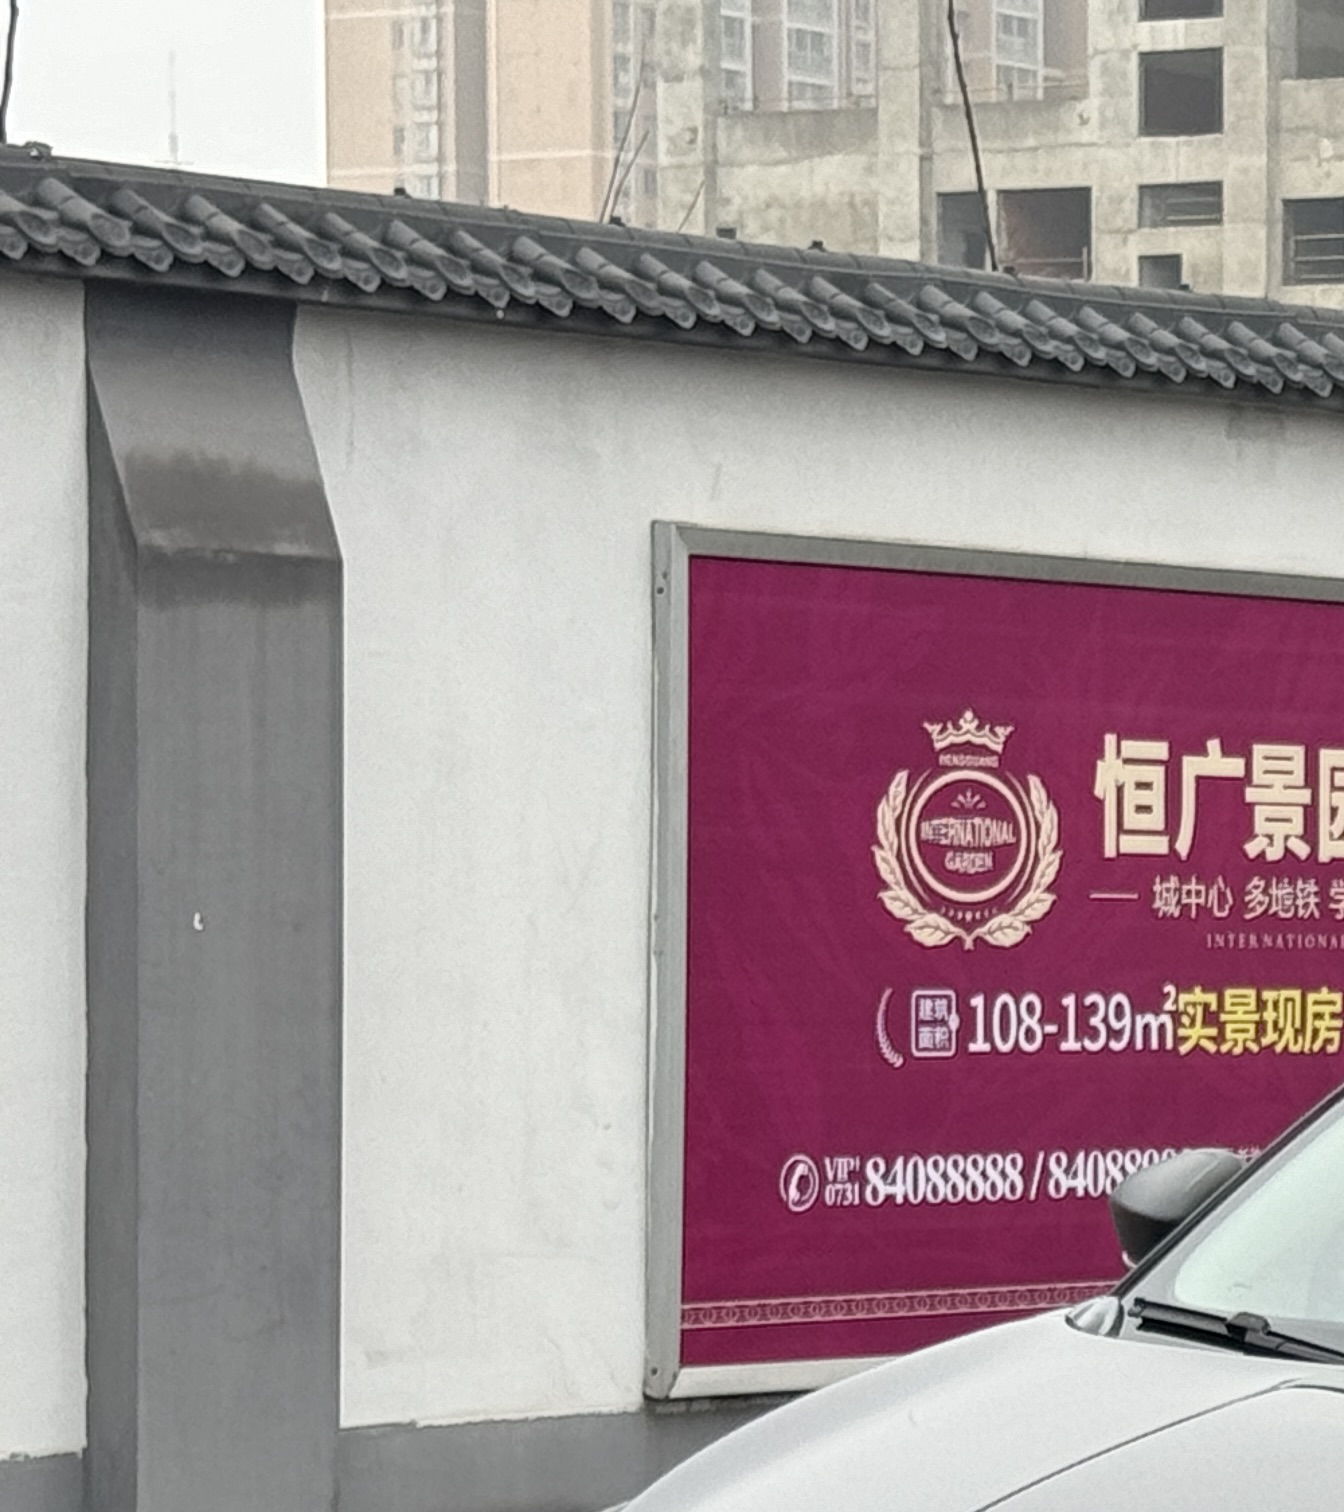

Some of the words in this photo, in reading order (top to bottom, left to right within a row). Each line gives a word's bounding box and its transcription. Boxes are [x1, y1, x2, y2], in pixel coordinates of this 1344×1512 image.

[919, 816, 1017, 848] INTERNATIONAL
[1151, 874, 1234, 919] 城中心
[1243, 875, 1321, 920] 多地铁
[917, 1026, 950, 1050] 面积
[823, 1182, 860, 1207] 0731
[864, 1151, 1024, 1207] 84088888
